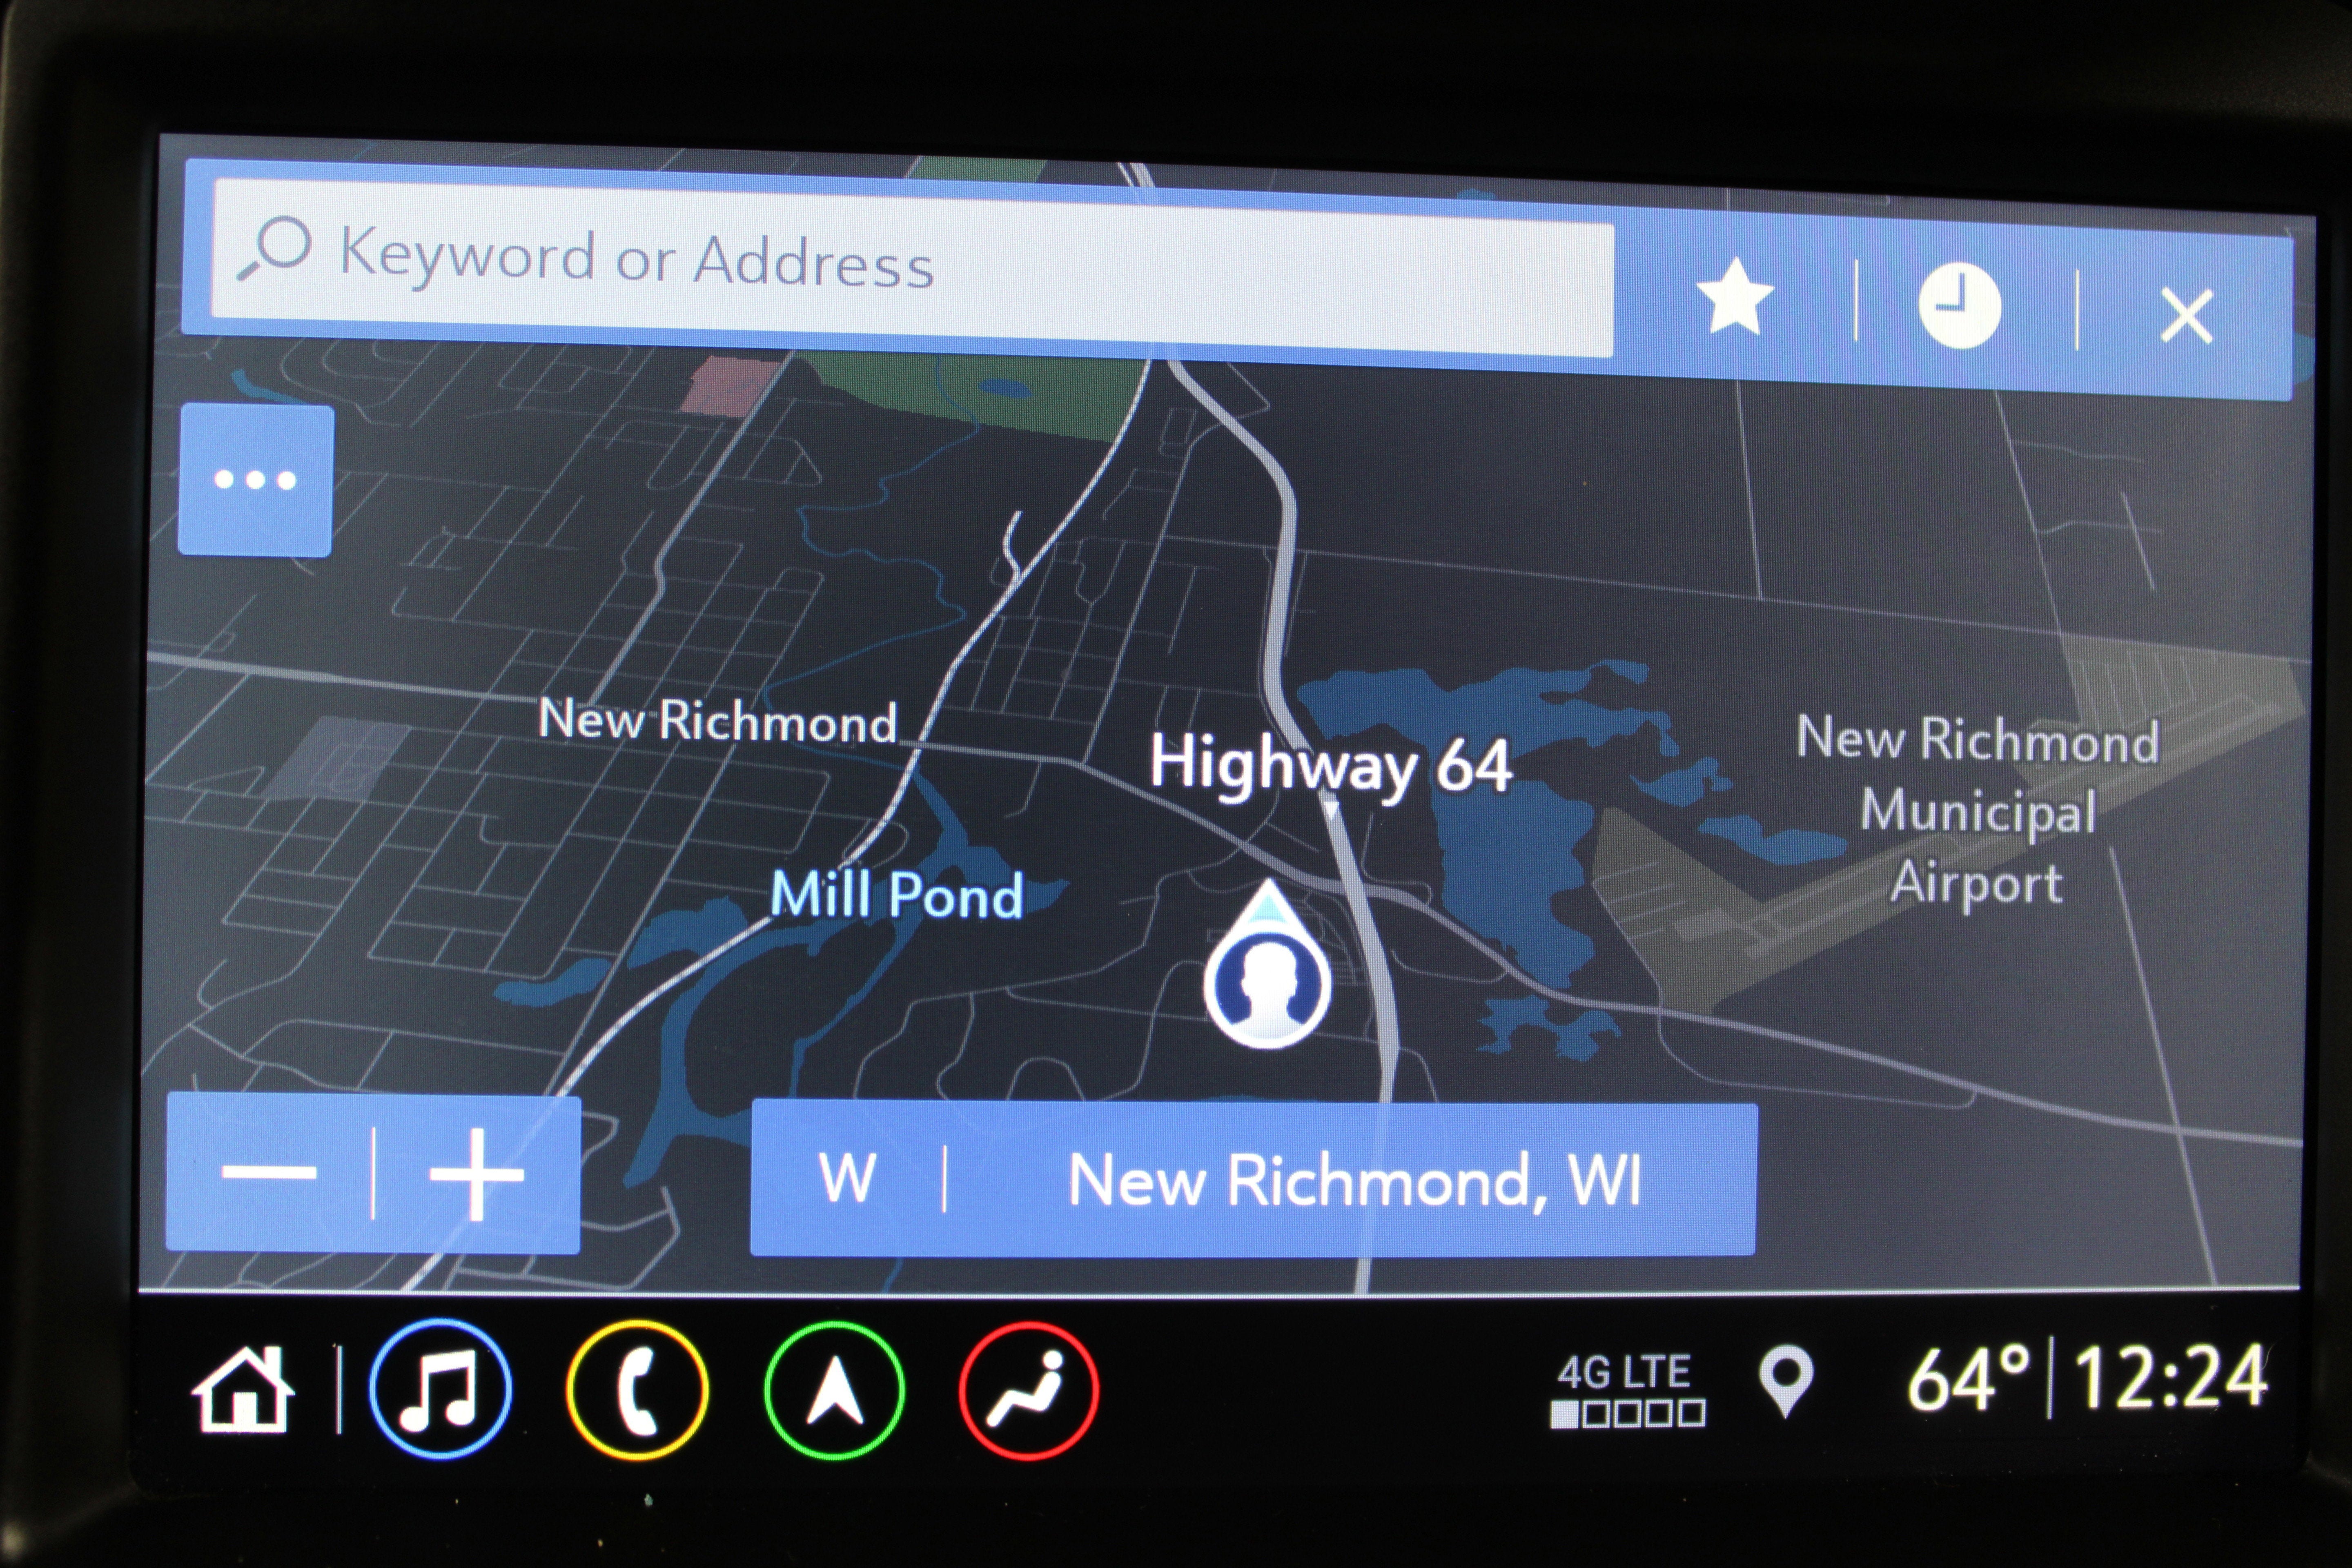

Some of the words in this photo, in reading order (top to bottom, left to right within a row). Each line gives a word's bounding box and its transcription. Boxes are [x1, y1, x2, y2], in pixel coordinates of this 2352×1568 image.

[342, 225, 595, 293] Keyword
[617, 247, 677, 282] or
[692, 234, 934, 289] Address
[539, 696, 646, 739] New
[661, 697, 897, 743] Richmond
[1798, 714, 1906, 758] New
[1922, 715, 2158, 764] Richmond
[1152, 731, 1419, 808] Highway
[1437, 737, 1514, 792] 64
[1862, 786, 2095, 844] Municipal
[771, 868, 869, 917] Mill
[890, 870, 1023, 919] Pond
[1891, 858, 2063, 916] Airport
[818, 1152, 878, 1203] W
[1070, 1152, 1207, 1206] New
[1229, 1149, 1548, 1216] Richmond,
[1567, 1152, 1641, 1206] WI
[1557, 1354, 1610, 1389] 4G
[1624, 1354, 1691, 1389] LTE
[2076, 1343, 2269, 1409] 12:24
